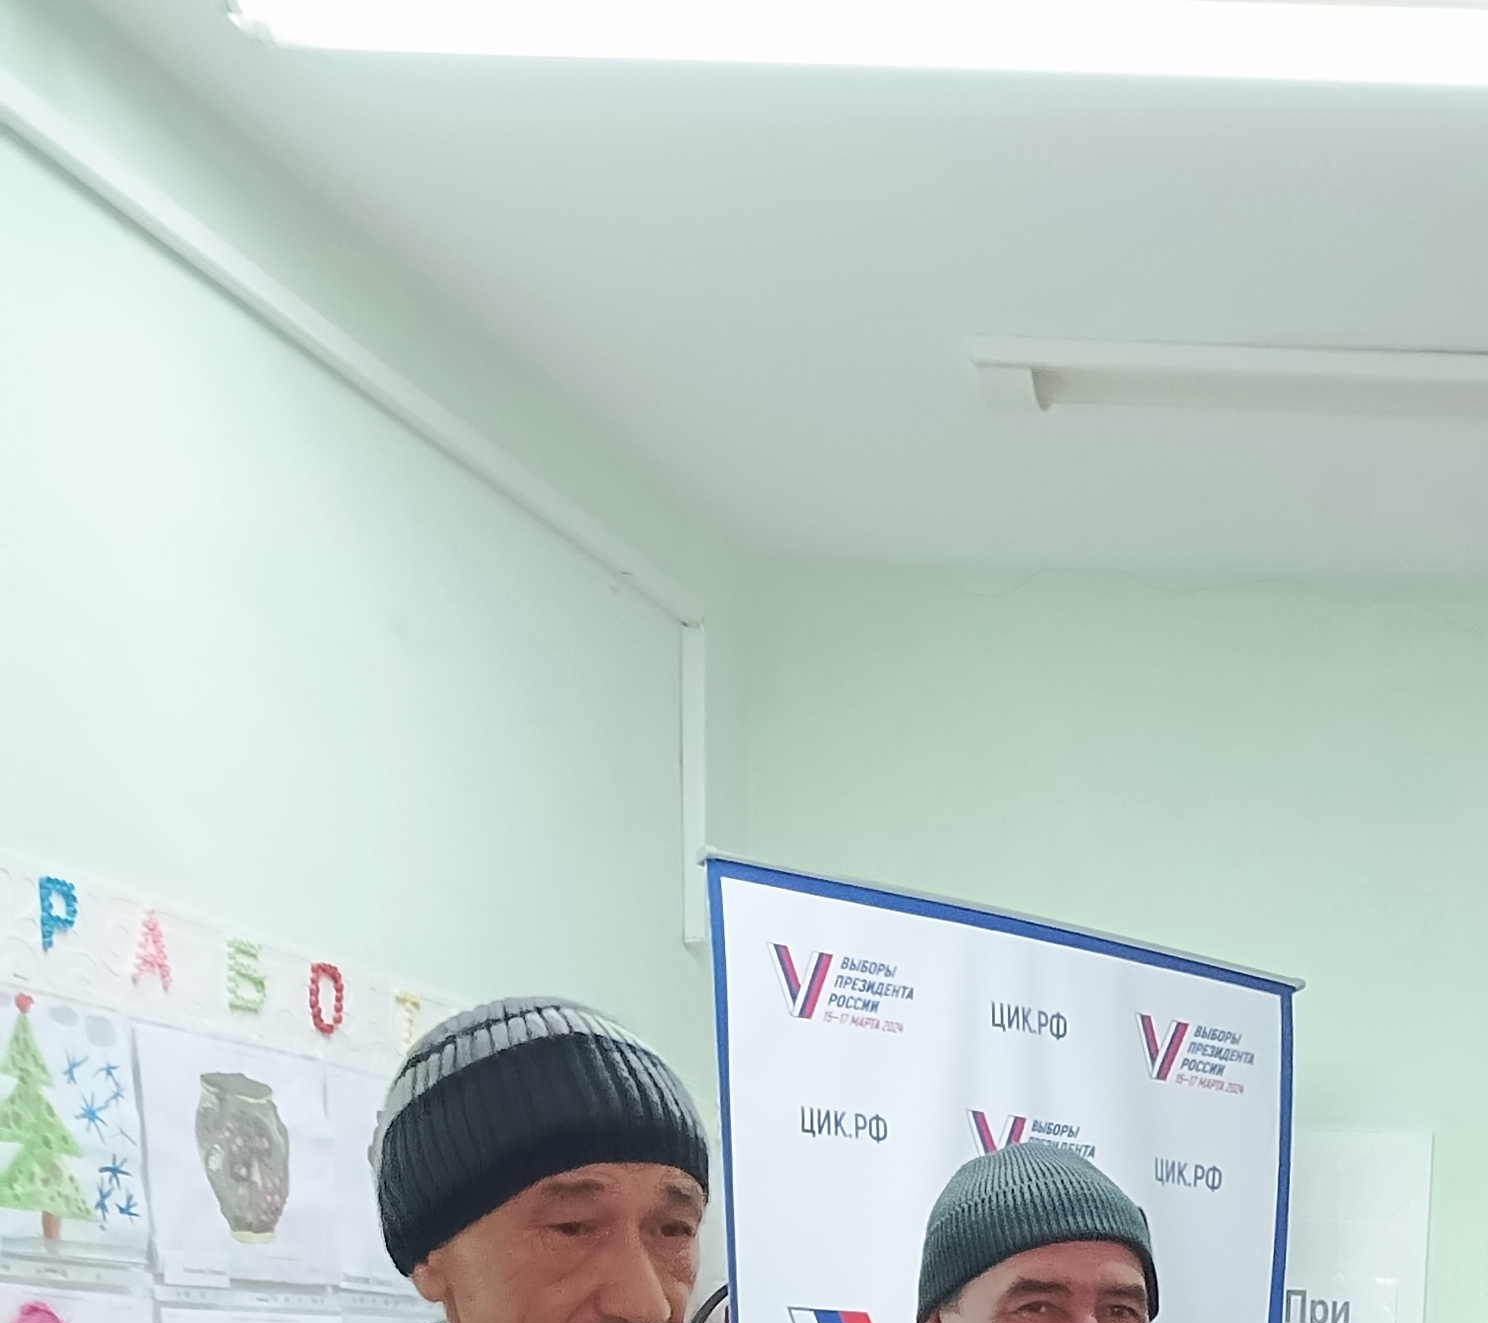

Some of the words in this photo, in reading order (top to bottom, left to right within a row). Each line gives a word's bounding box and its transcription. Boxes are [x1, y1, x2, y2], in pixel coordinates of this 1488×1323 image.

[840, 956, 898, 978] ВЫБОРЫ
[834, 975, 914, 1000] ПРЕЗИДЕНТА
[828, 993, 881, 1014] РОССИИ
[850, 1015, 881, 1030] МАРТА
[881, 1020, 904, 1034] 2024
[991, 1001, 1067, 1040] ЦИК.РФ
[1193, 1025, 1242, 1045] ВЫБОРЫ
[1187, 1041, 1255, 1065] ПРЕЗИДЕНТА
[1180, 1057, 1226, 1077] РОССИИ
[1198, 1077, 1225, 1092] МАРТА
[801, 1105, 888, 1144] ЦИК.РФ
[1031, 1119, 1080, 1139] ВЫБОРЫ
[1155, 1157, 1222, 1192] ЦИК.РФ
